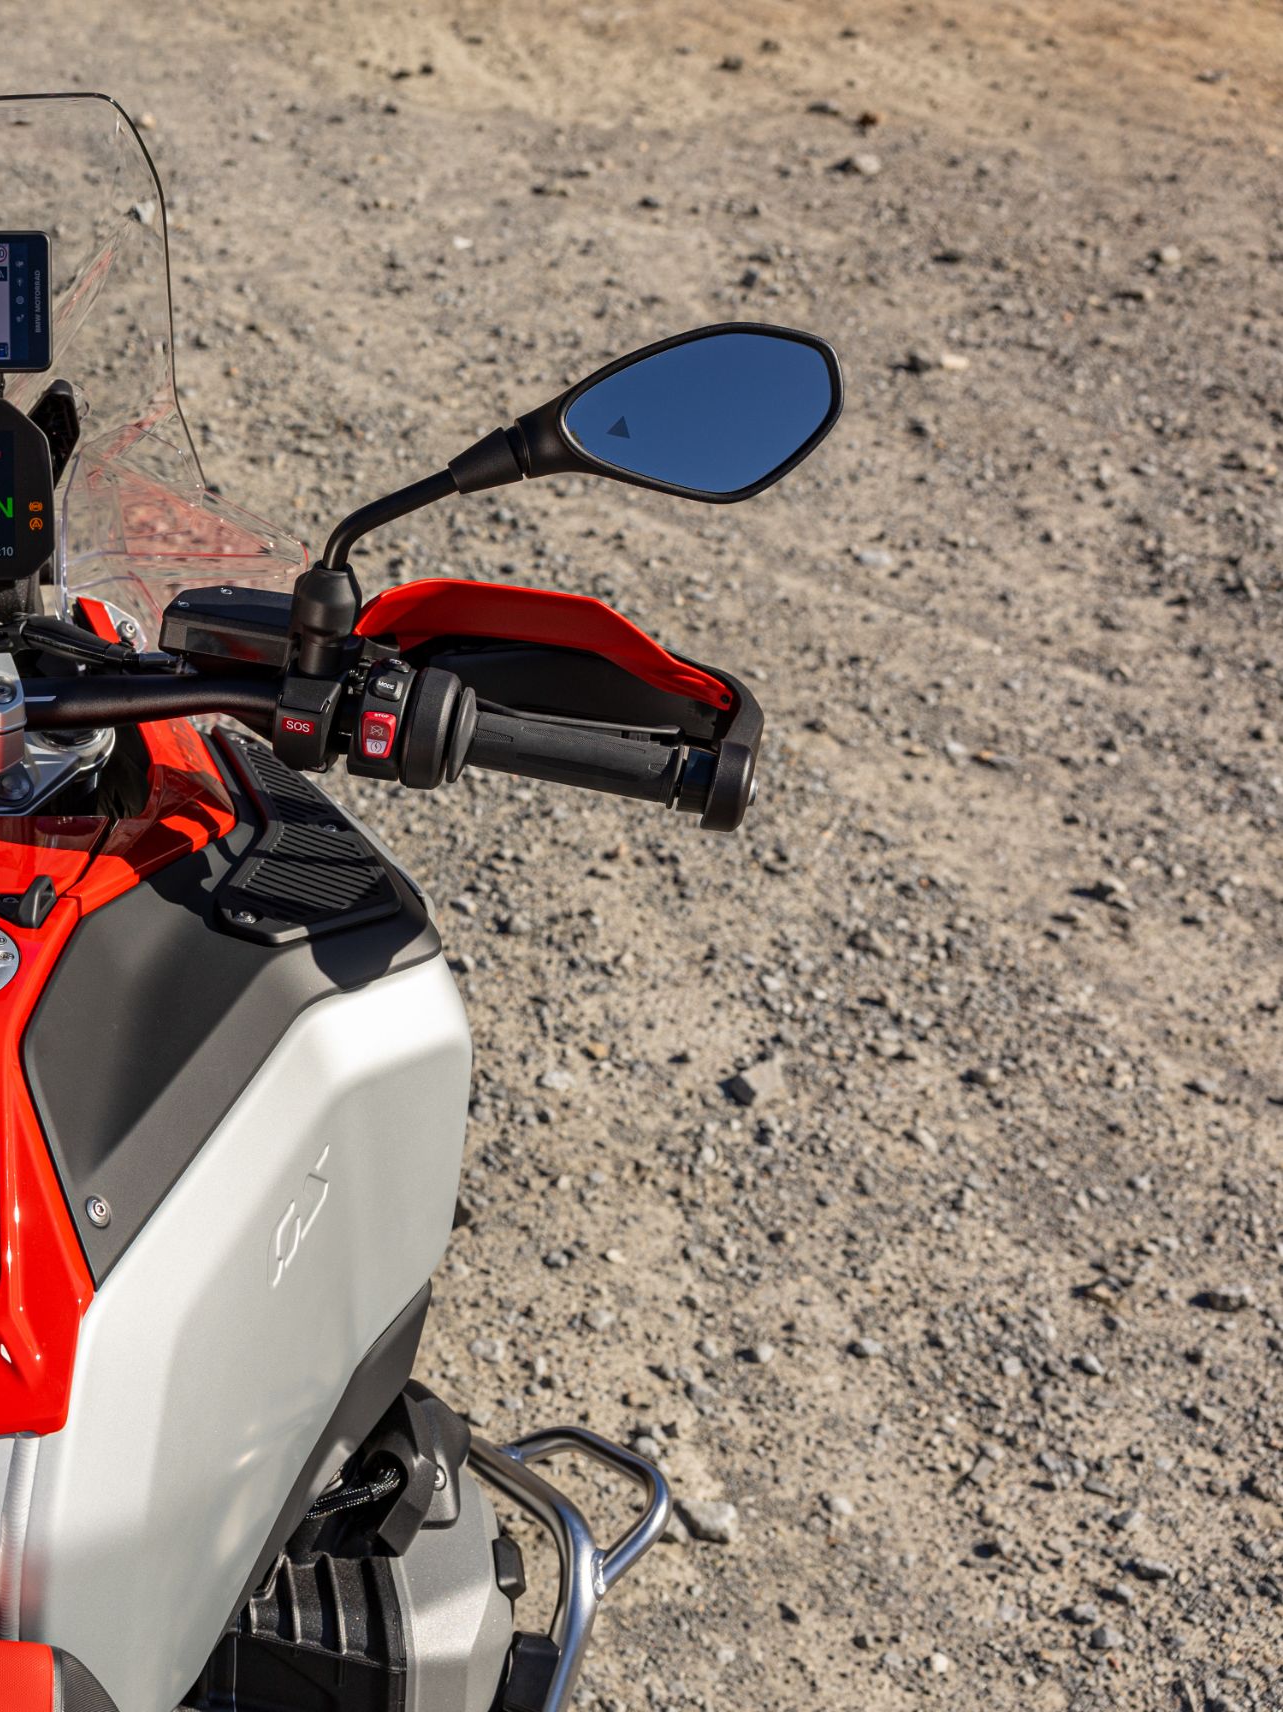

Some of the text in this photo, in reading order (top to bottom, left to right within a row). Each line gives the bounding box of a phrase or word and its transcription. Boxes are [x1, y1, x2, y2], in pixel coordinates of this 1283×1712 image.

[34, 314, 42, 333] BMW
[378, 680, 395, 690] MODE
[286, 720, 310, 733] SOS
